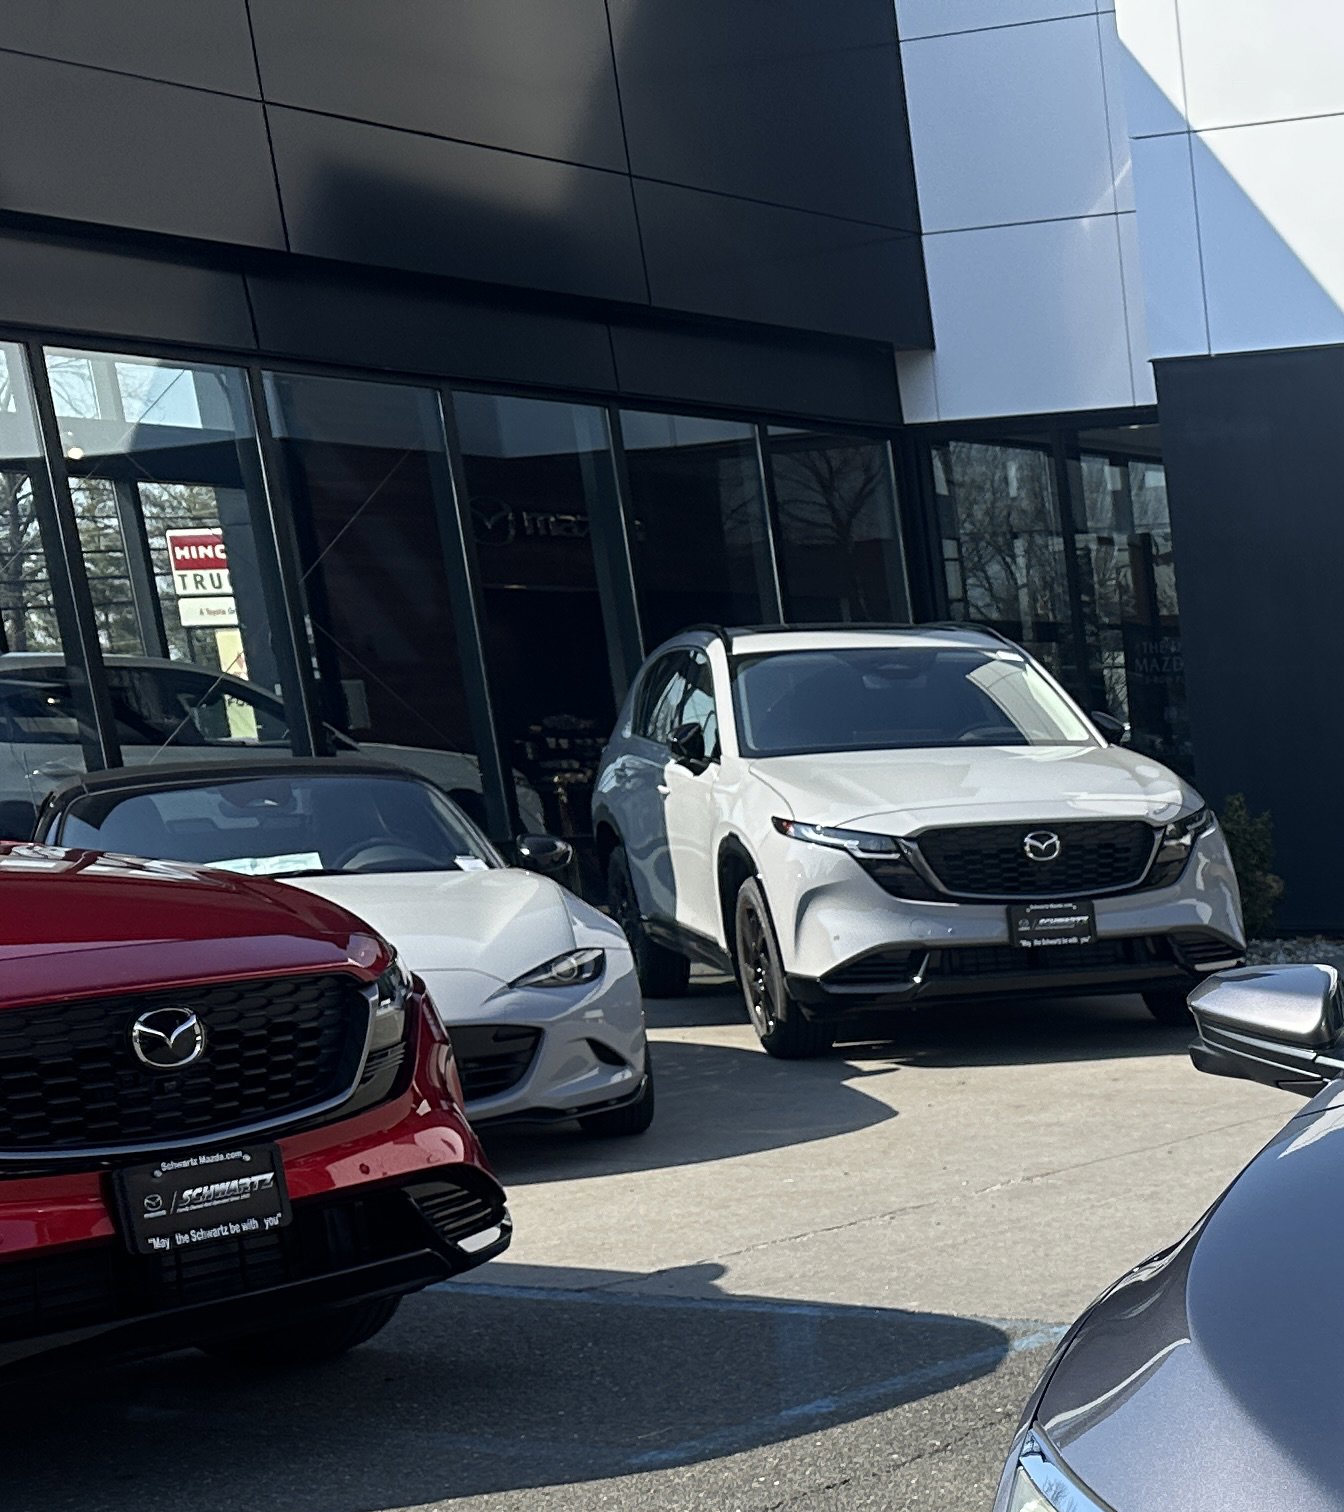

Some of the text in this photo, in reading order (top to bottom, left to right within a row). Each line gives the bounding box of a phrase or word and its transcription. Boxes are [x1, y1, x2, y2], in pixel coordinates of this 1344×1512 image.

[177, 572, 231, 591] TRU
[178, 1171, 275, 1207] SCHWARTZ
[175, 1233, 190, 1245] the
[190, 1224, 229, 1242] Schwartz
[229, 1222, 241, 1234] be
[241, 1218, 259, 1231] with
